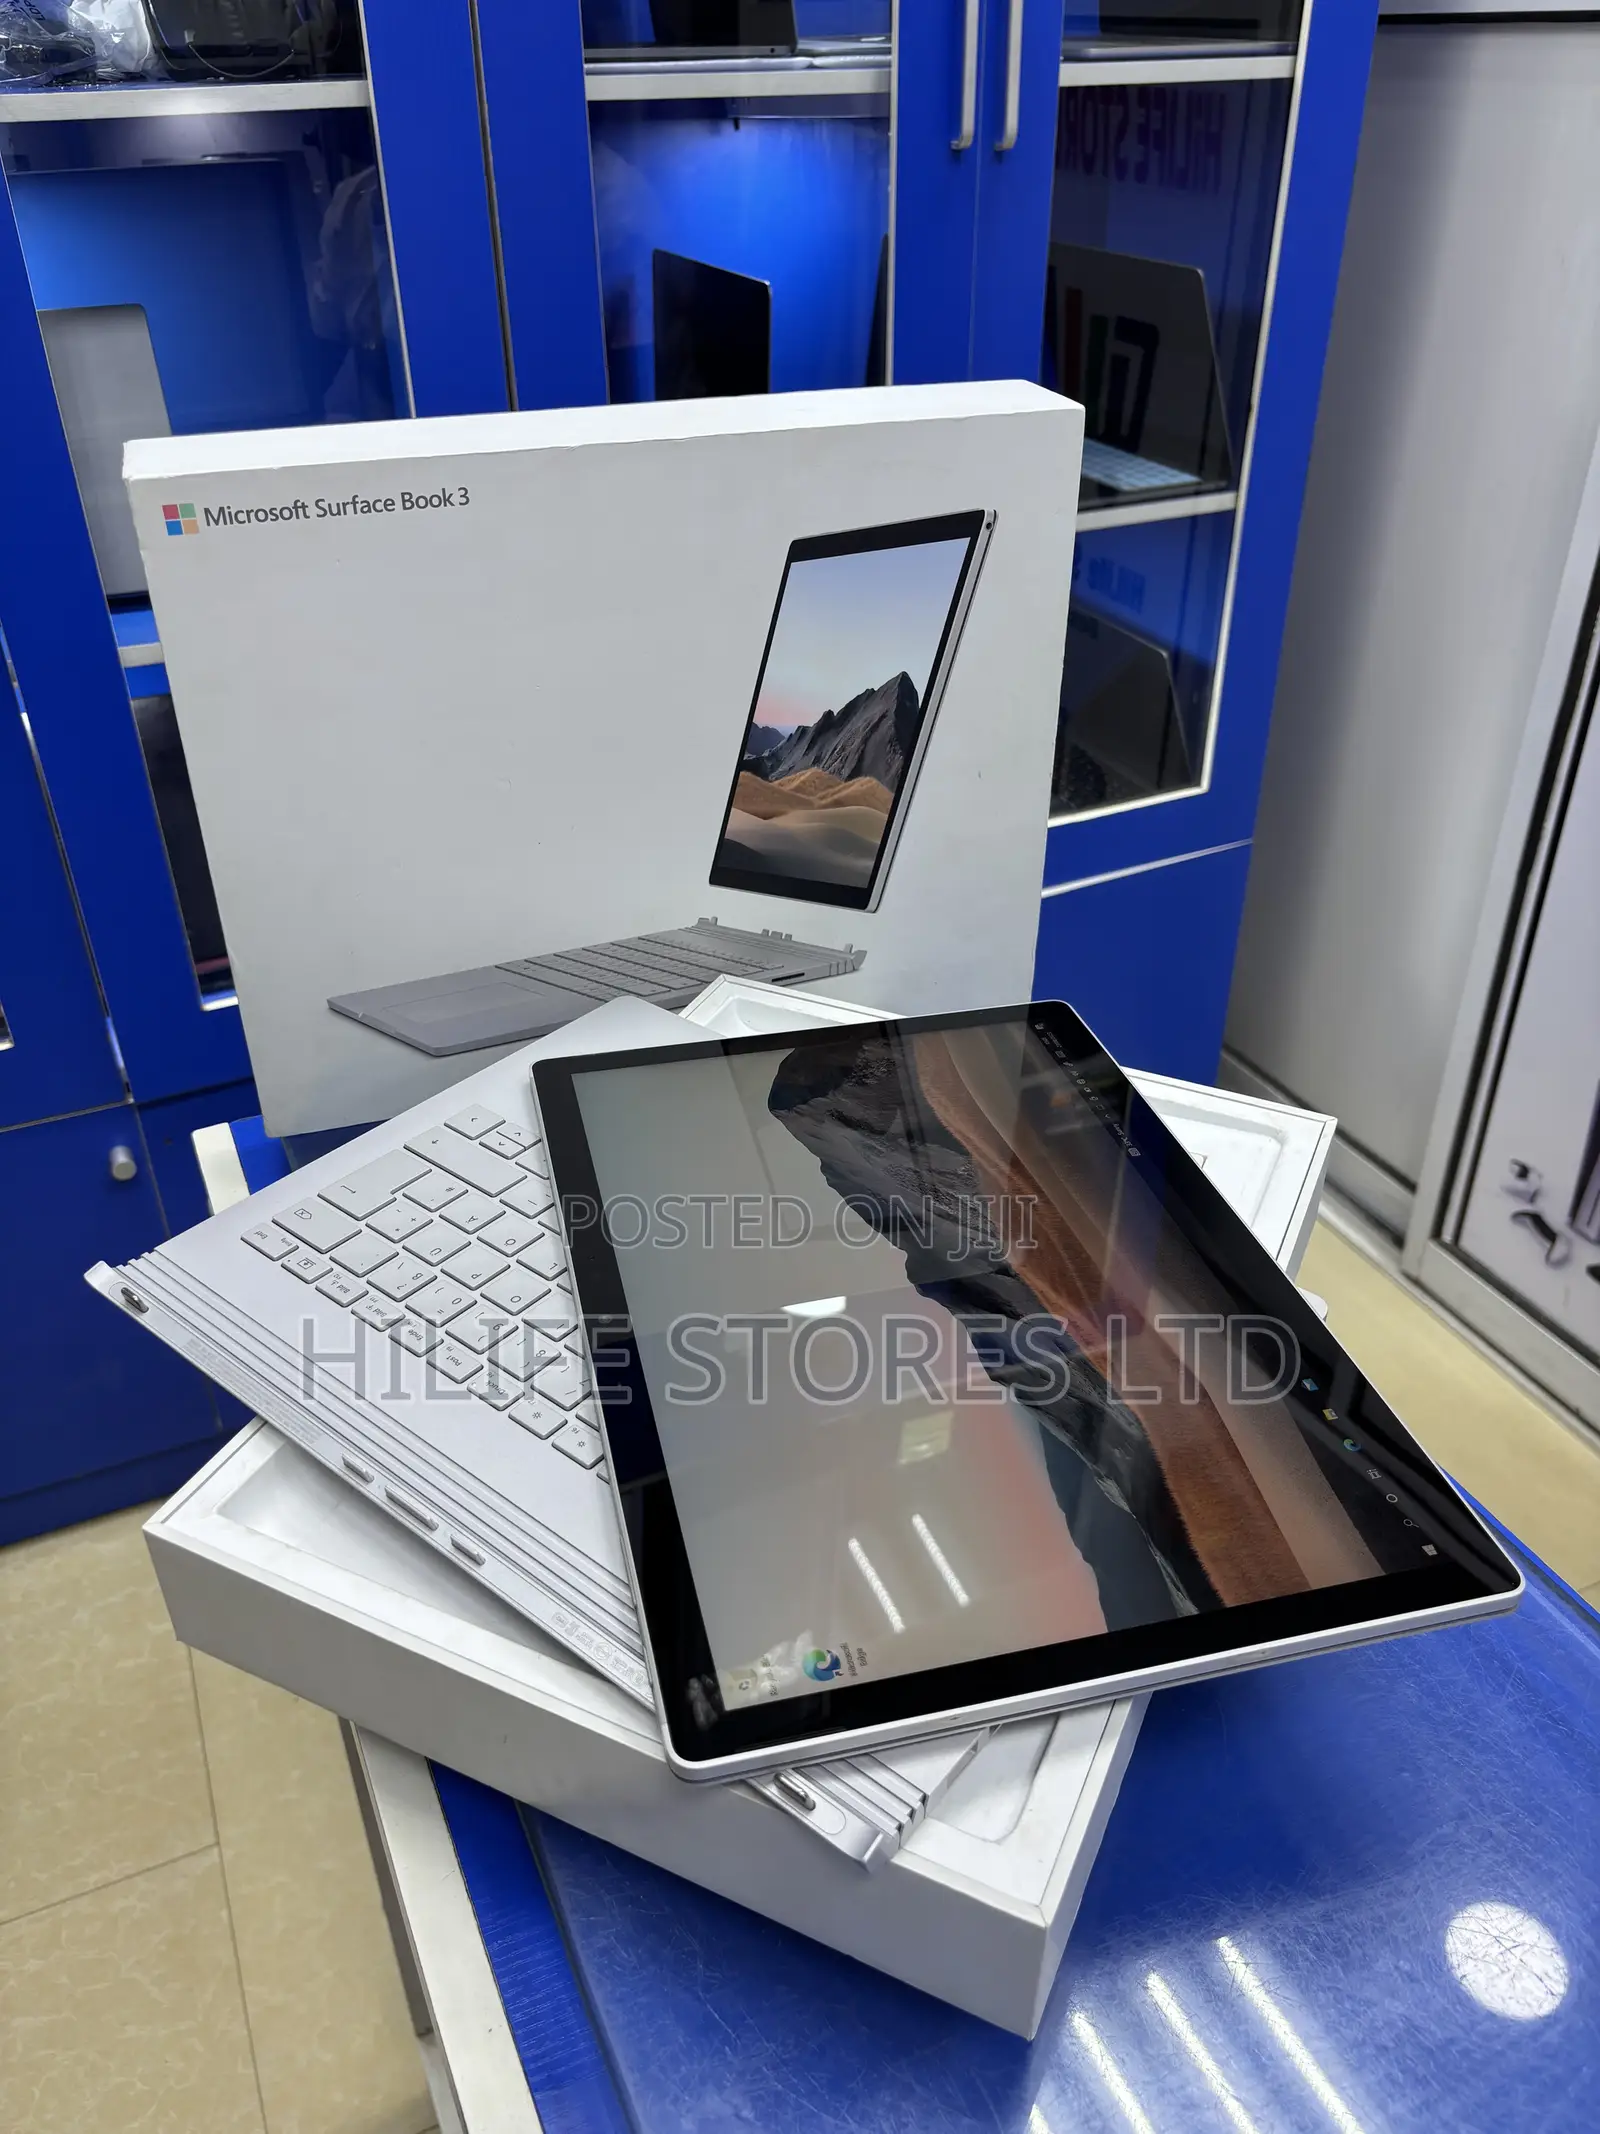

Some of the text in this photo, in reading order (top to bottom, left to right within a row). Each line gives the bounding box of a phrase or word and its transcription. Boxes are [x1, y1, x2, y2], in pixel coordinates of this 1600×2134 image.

[203, 486, 470, 527] Microsoft Surface Book 3
[470, 1272, 482, 1280] P
[407, 1328, 424, 1342] Ende
[446, 1355, 462, 1367] Post
[485, 1380, 506, 1396] Druck
